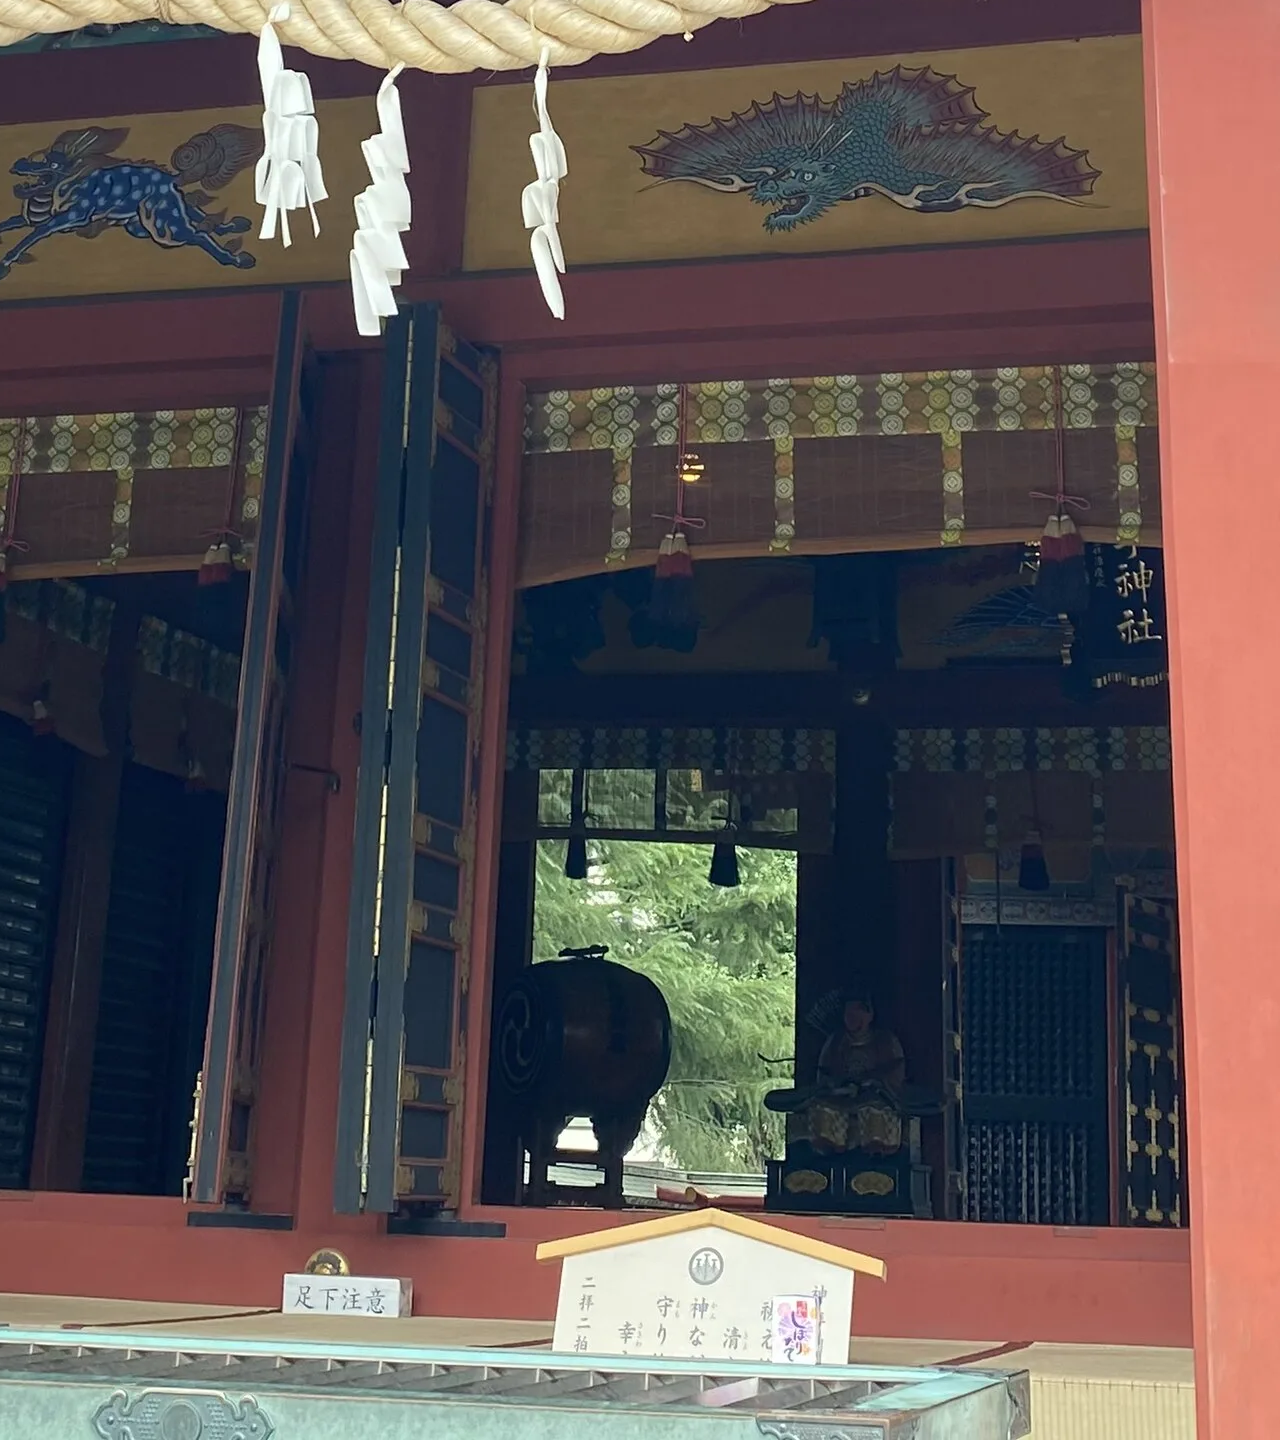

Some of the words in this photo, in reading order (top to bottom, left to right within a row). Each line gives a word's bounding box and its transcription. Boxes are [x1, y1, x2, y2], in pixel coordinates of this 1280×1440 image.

[293, 1285, 387, 1314] 足下注意
[654, 1295, 675, 1357] 守り
[688, 1296, 710, 1358] 神な
